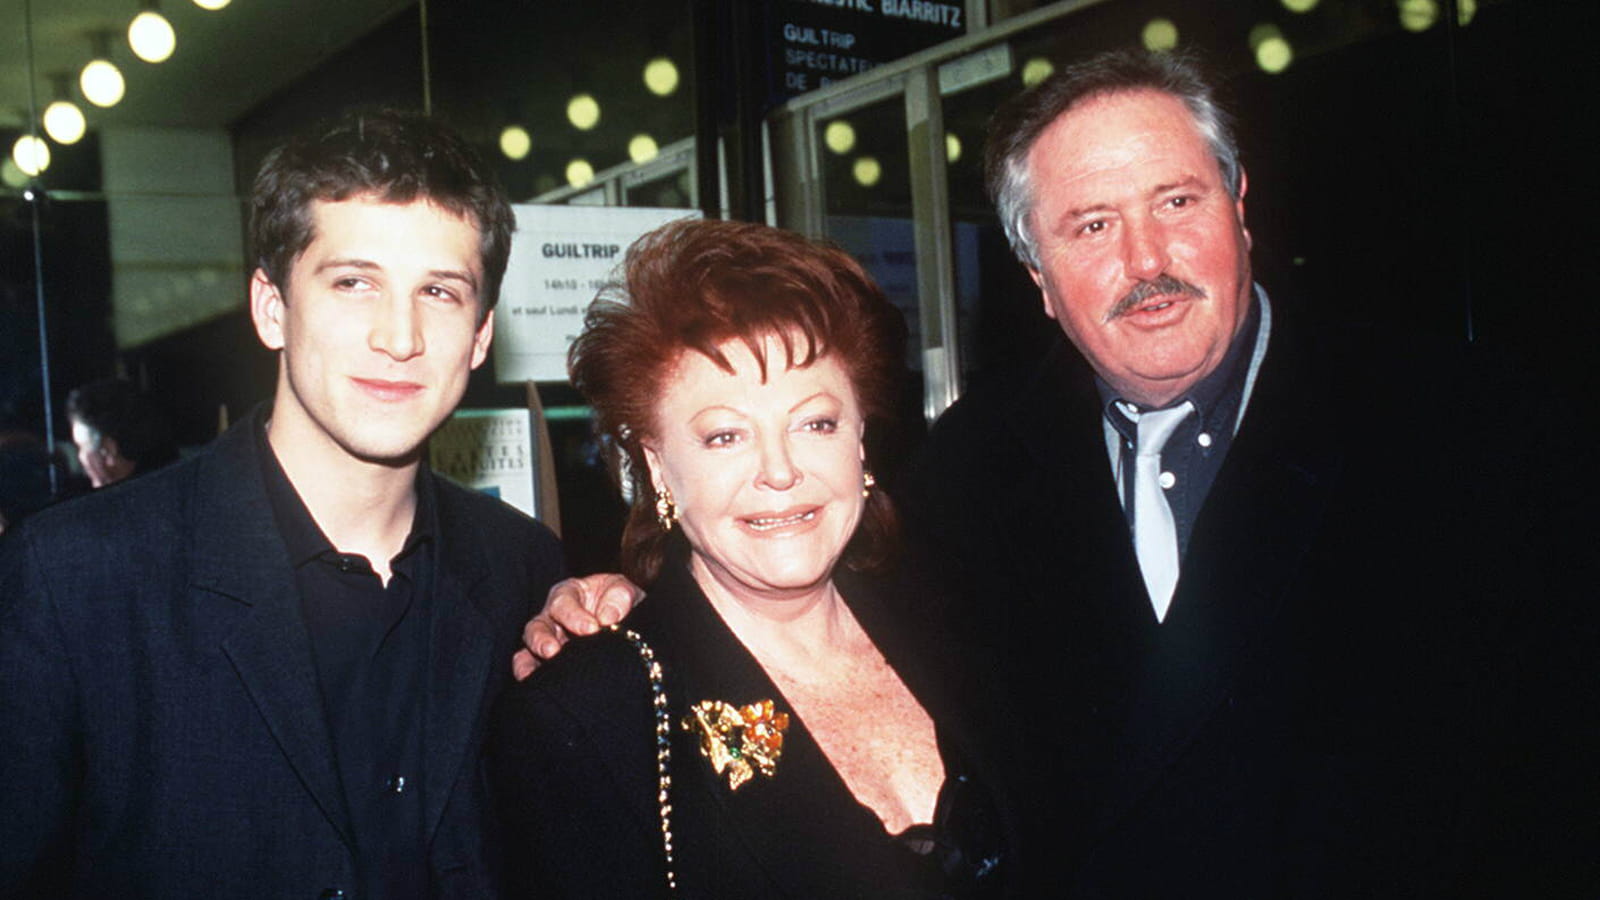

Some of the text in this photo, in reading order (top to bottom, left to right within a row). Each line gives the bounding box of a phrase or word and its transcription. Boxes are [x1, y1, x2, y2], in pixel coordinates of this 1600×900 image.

[881, 0, 961, 27] BIARRITZ
[785, 71, 808, 91] DE
[542, 243, 620, 258] GUILTRIP
[550, 305, 578, 315] Lundi
